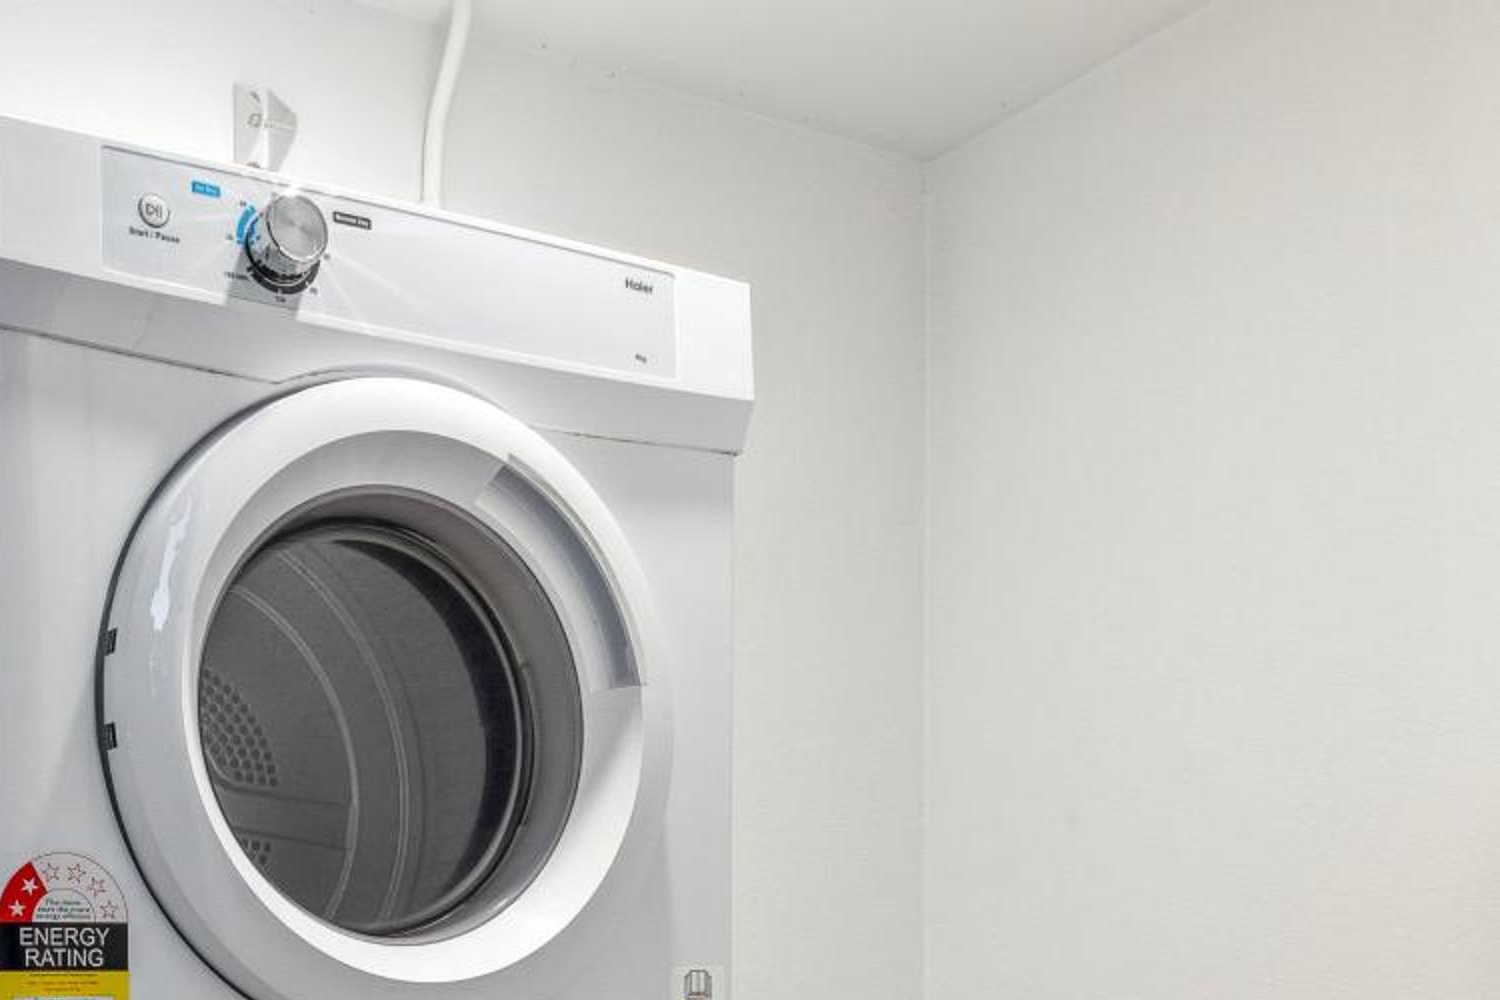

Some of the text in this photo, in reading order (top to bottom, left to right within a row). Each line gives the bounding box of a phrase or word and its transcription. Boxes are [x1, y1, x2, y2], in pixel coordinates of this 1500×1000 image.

[624, 277, 653, 296] Haier
[20, 927, 110, 947] ENERGY
[25, 948, 105, 968] RATING
